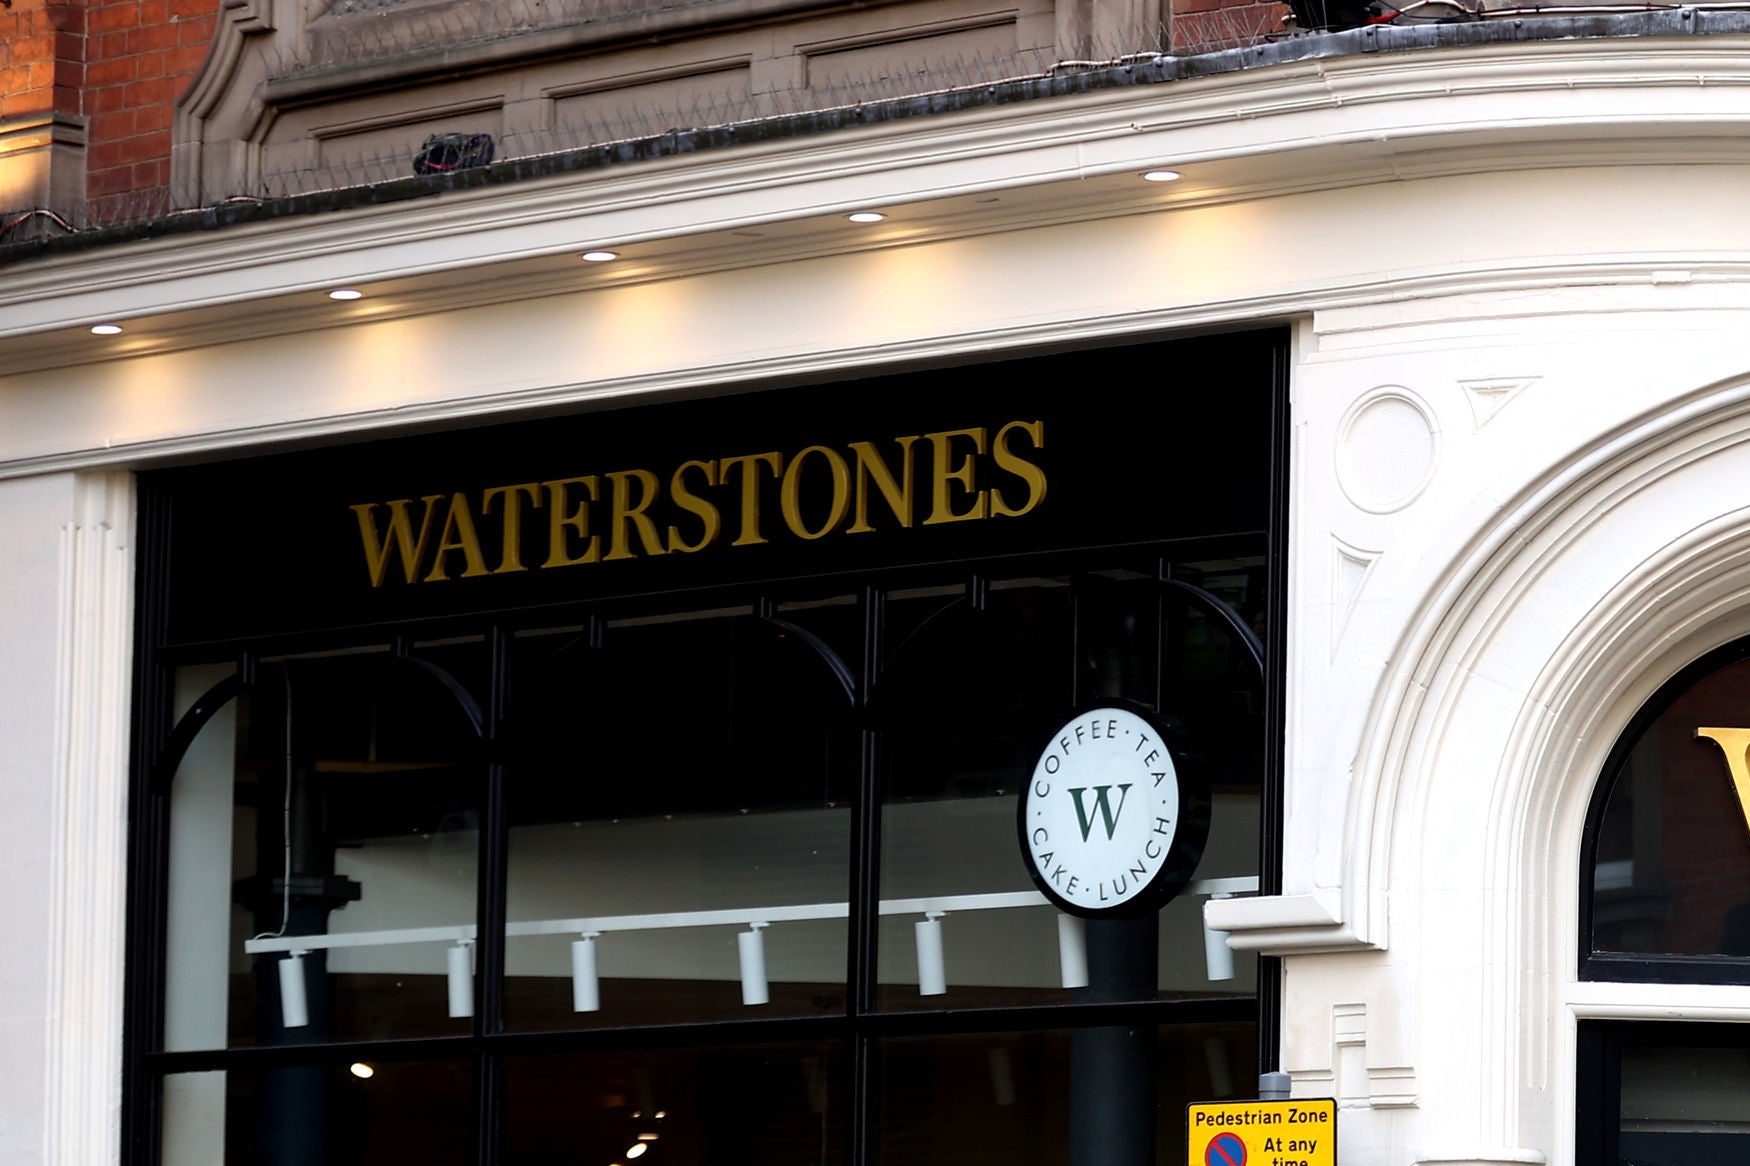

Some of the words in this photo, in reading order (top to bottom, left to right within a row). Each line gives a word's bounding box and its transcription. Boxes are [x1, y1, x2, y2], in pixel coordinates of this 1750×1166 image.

[350, 420, 1047, 588] WATERSTONES
[1035, 719, 1117, 799] COFFEE
[1135, 733, 1167, 788] TEA
[1067, 783, 1133, 843] W
[1032, 827, 1078, 896] CAKE
[1098, 816, 1171, 902] LUNCH
[1196, 1110, 1282, 1127] Pedestrian
[1288, 1108, 1328, 1124] Zone
[1264, 1137, 1282, 1153] At
[1289, 1140, 1317, 1154] any
